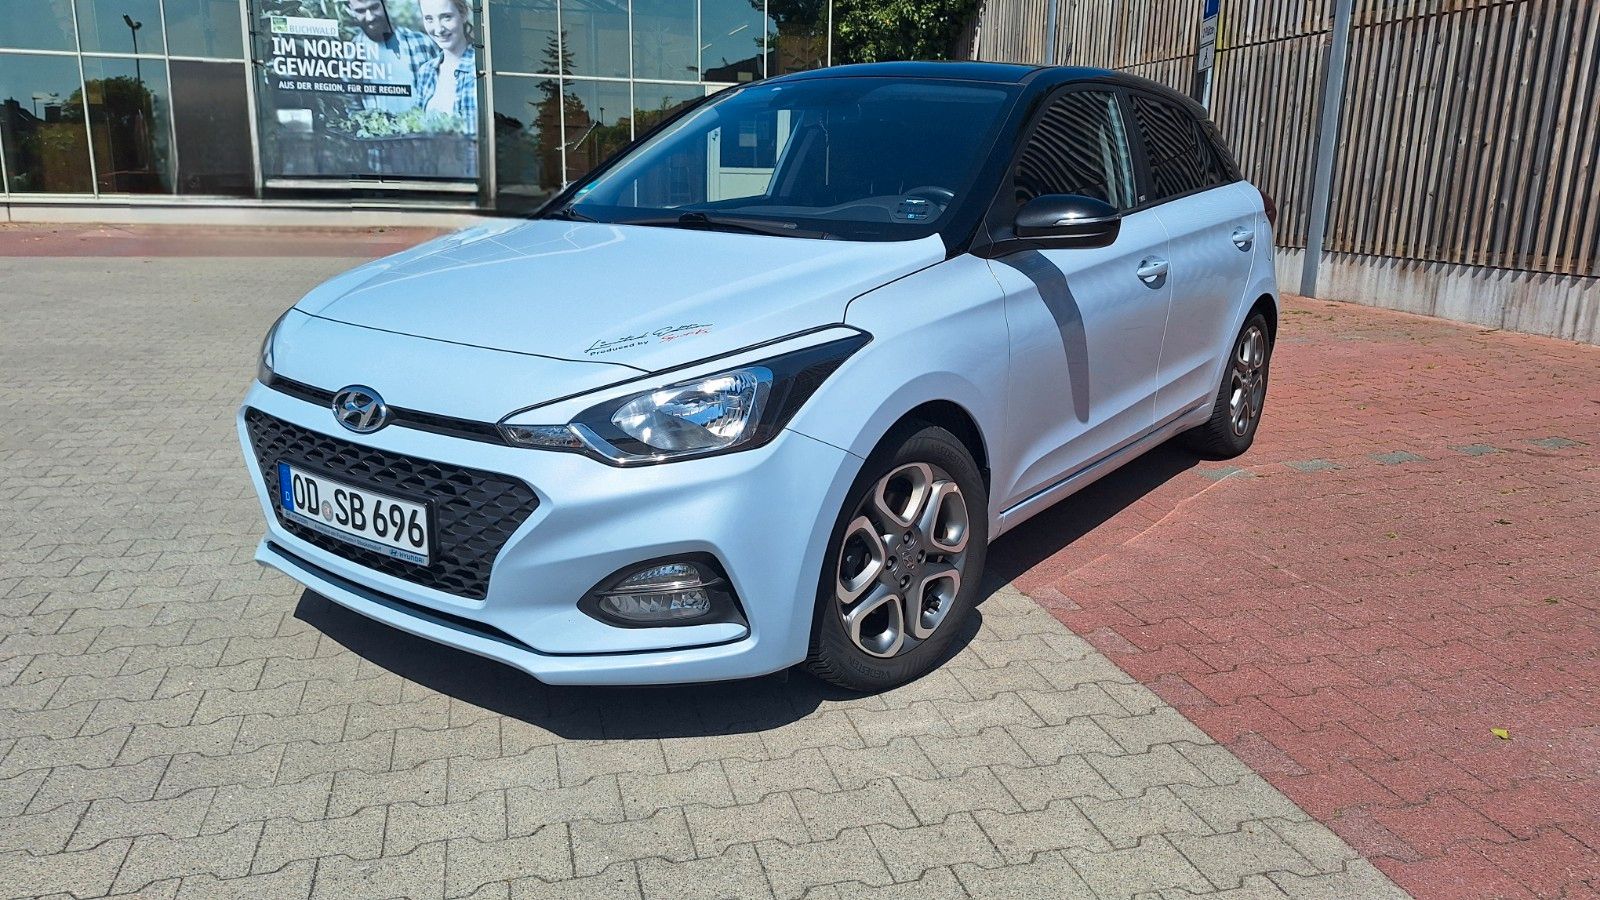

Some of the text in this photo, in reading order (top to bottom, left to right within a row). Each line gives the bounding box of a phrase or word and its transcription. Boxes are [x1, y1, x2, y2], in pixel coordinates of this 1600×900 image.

[290, 25, 337, 35] BUCHWALD
[272, 36, 379, 60] IM NORDEN
[273, 57, 393, 80] GEWACHSEN!
[278, 81, 295, 90] AUS
[297, 82, 312, 90] DER
[347, 84, 362, 92] FÜR
[364, 85, 377, 94] DIE
[590, 342, 635, 357] Produced
[285, 490, 291, 502] D
[293, 473, 320, 516] OD
[334, 488, 367, 531] SB
[373, 500, 425, 548] 696
[399, 551, 425, 564] HYUNDAI
